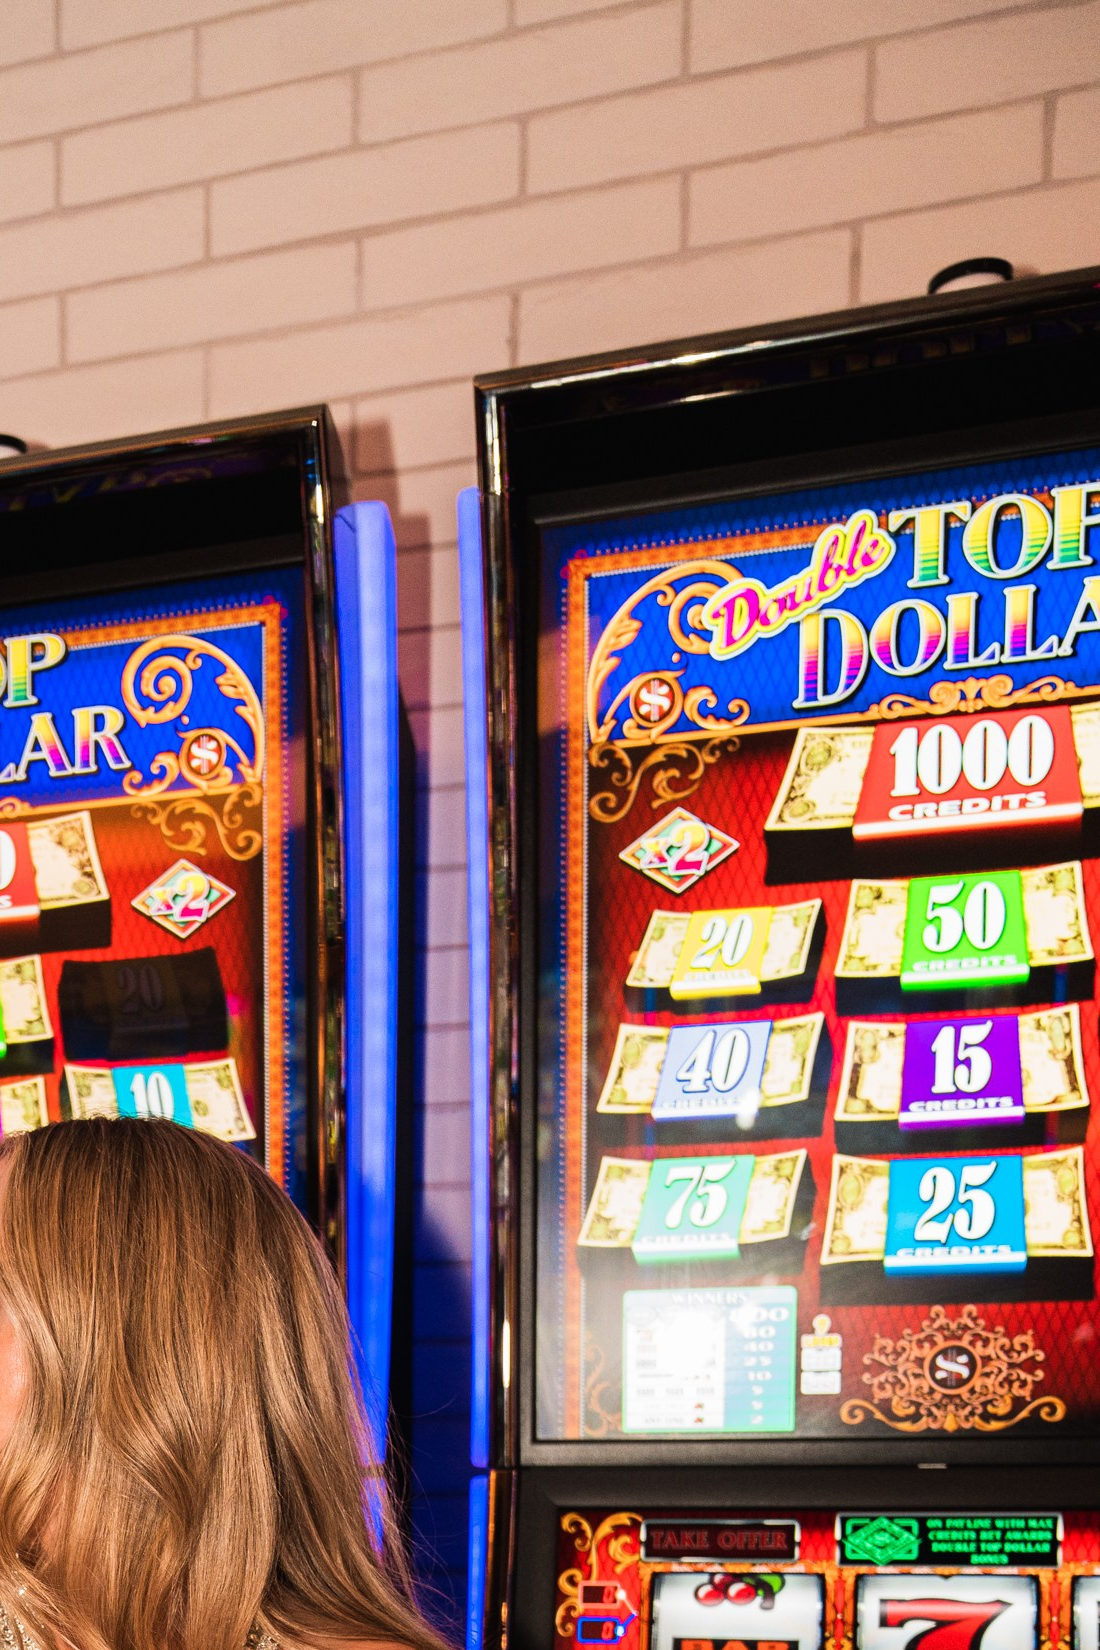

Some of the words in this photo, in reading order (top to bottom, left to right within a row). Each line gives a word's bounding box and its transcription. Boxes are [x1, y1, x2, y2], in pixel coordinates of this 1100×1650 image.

[704, 512, 895, 660] Double
[889, 714, 1055, 798] 1000
[888, 791, 1048, 821] CREDITS
[691, 912, 755, 972] 20
[922, 878, 1007, 953] 50
[912, 954, 1018, 972] CREDITS
[675, 1027, 752, 1094] 40
[929, 1020, 994, 1095] 15
[130, 1071, 175, 1120] 10
[908, 1093, 1016, 1114] CREDITS
[661, 1159, 737, 1229] 75
[912, 1159, 999, 1245] 25
[651, 1530, 709, 1549] TAKE
[717, 1531, 788, 1550] OFFER
